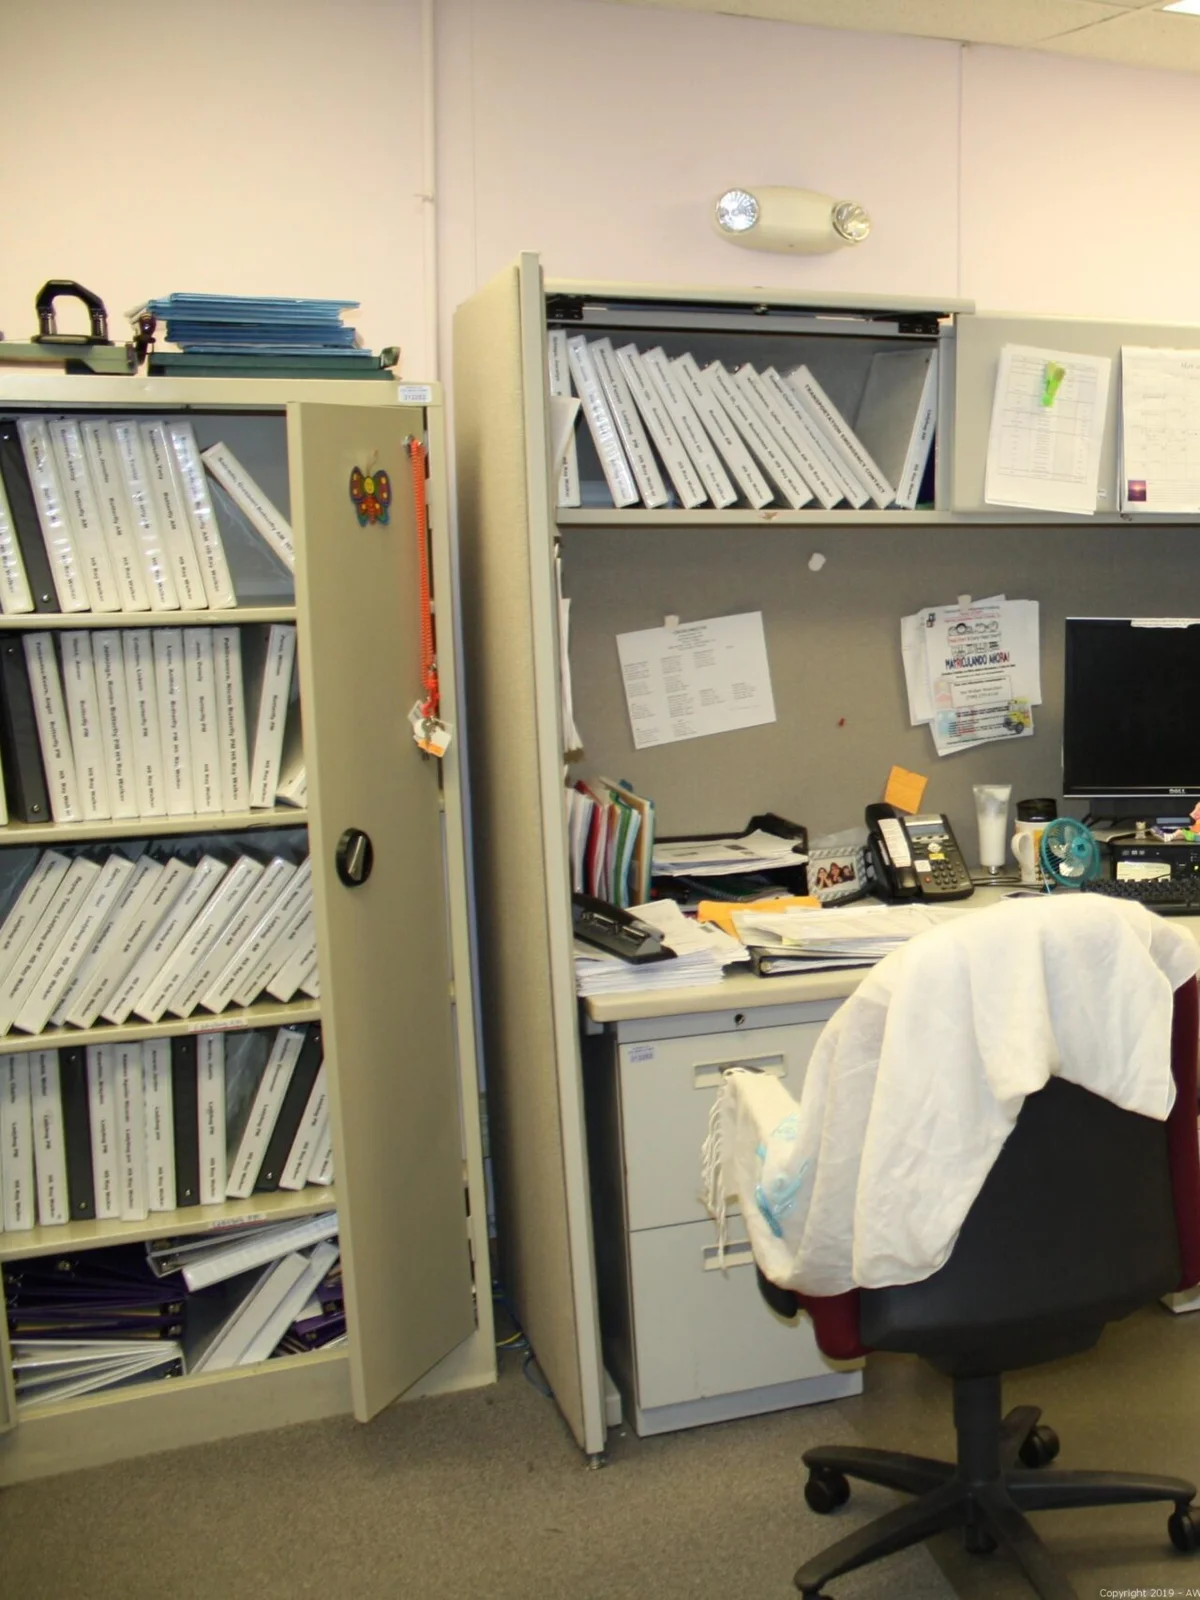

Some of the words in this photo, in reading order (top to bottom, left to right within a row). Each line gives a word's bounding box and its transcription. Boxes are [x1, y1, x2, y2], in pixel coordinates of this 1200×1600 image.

[805, 384, 842, 434] TRANSPORTATION
[841, 433, 867, 468] EMERGENCY
[865, 467, 886, 494] CONTACT
[944, 654, 988, 671] MATRICULANDO
